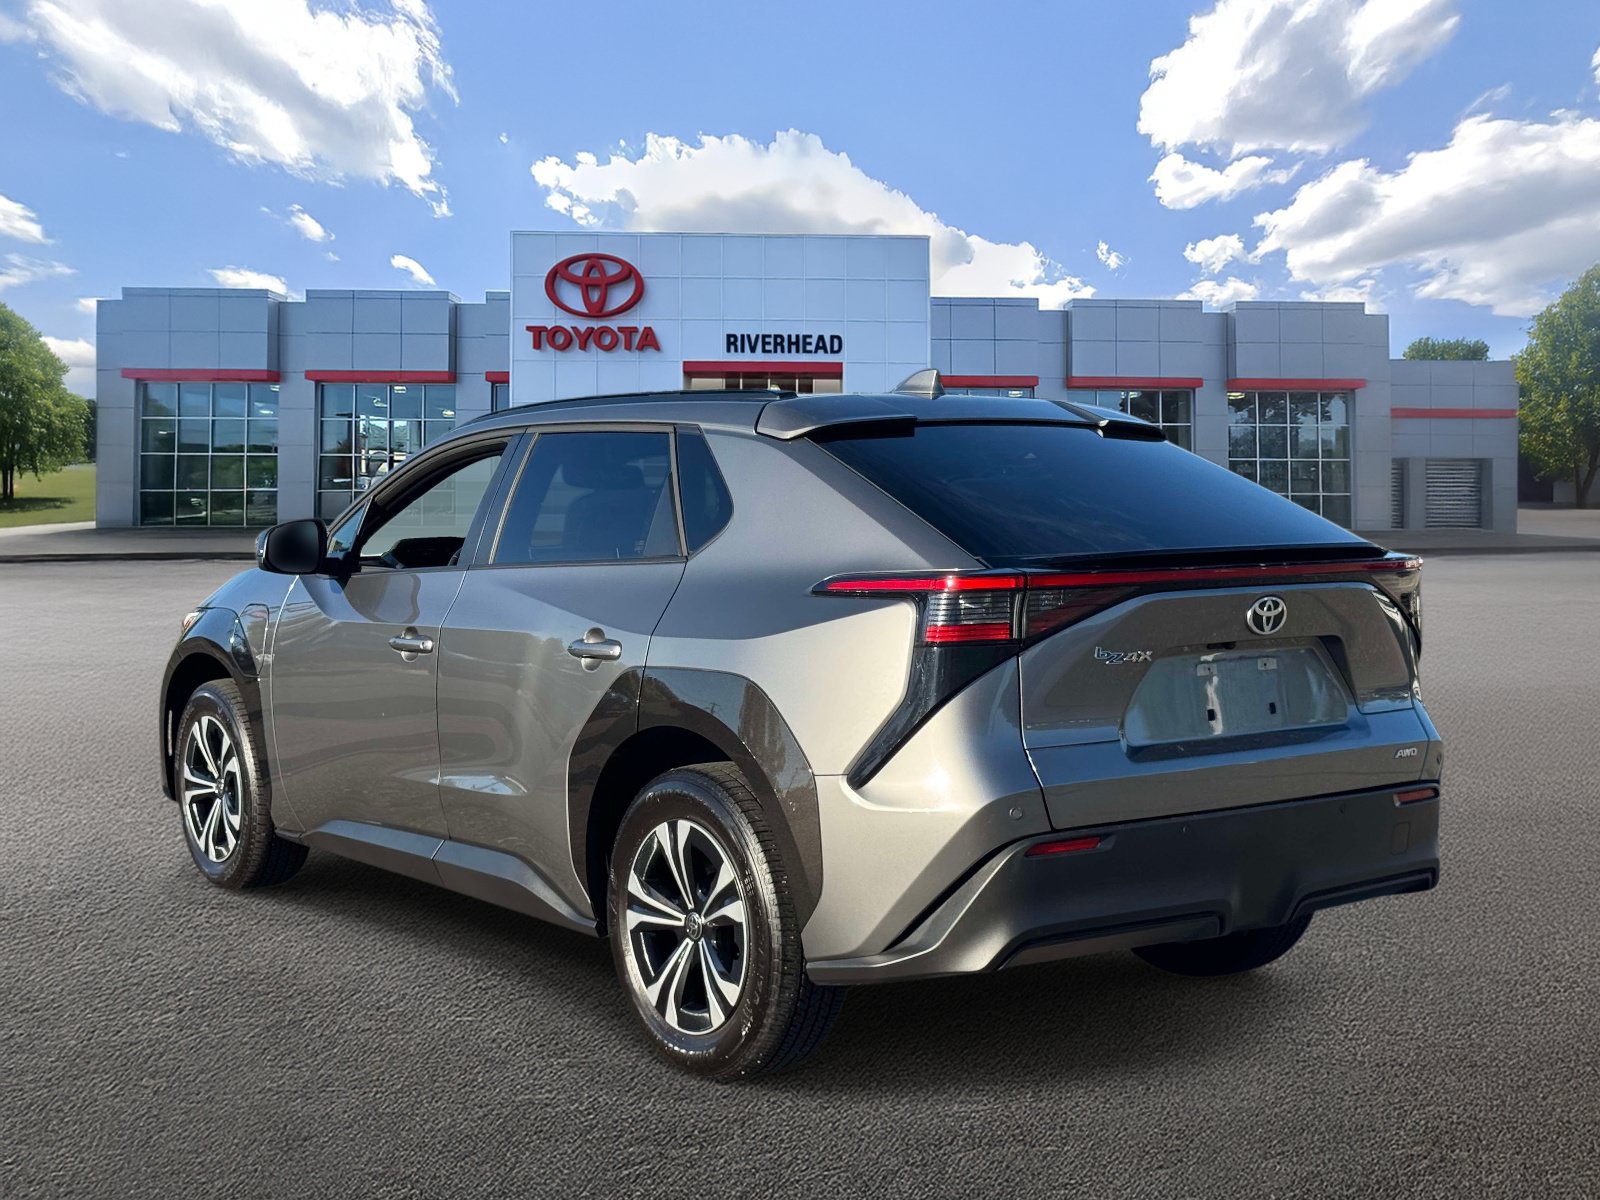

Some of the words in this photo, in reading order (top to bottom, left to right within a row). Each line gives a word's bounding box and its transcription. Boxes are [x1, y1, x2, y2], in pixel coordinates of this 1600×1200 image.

[525, 325, 661, 352] TOYOTA
[726, 333, 843, 355] RIVERHEAD
[1394, 747, 1418, 759] AWD
